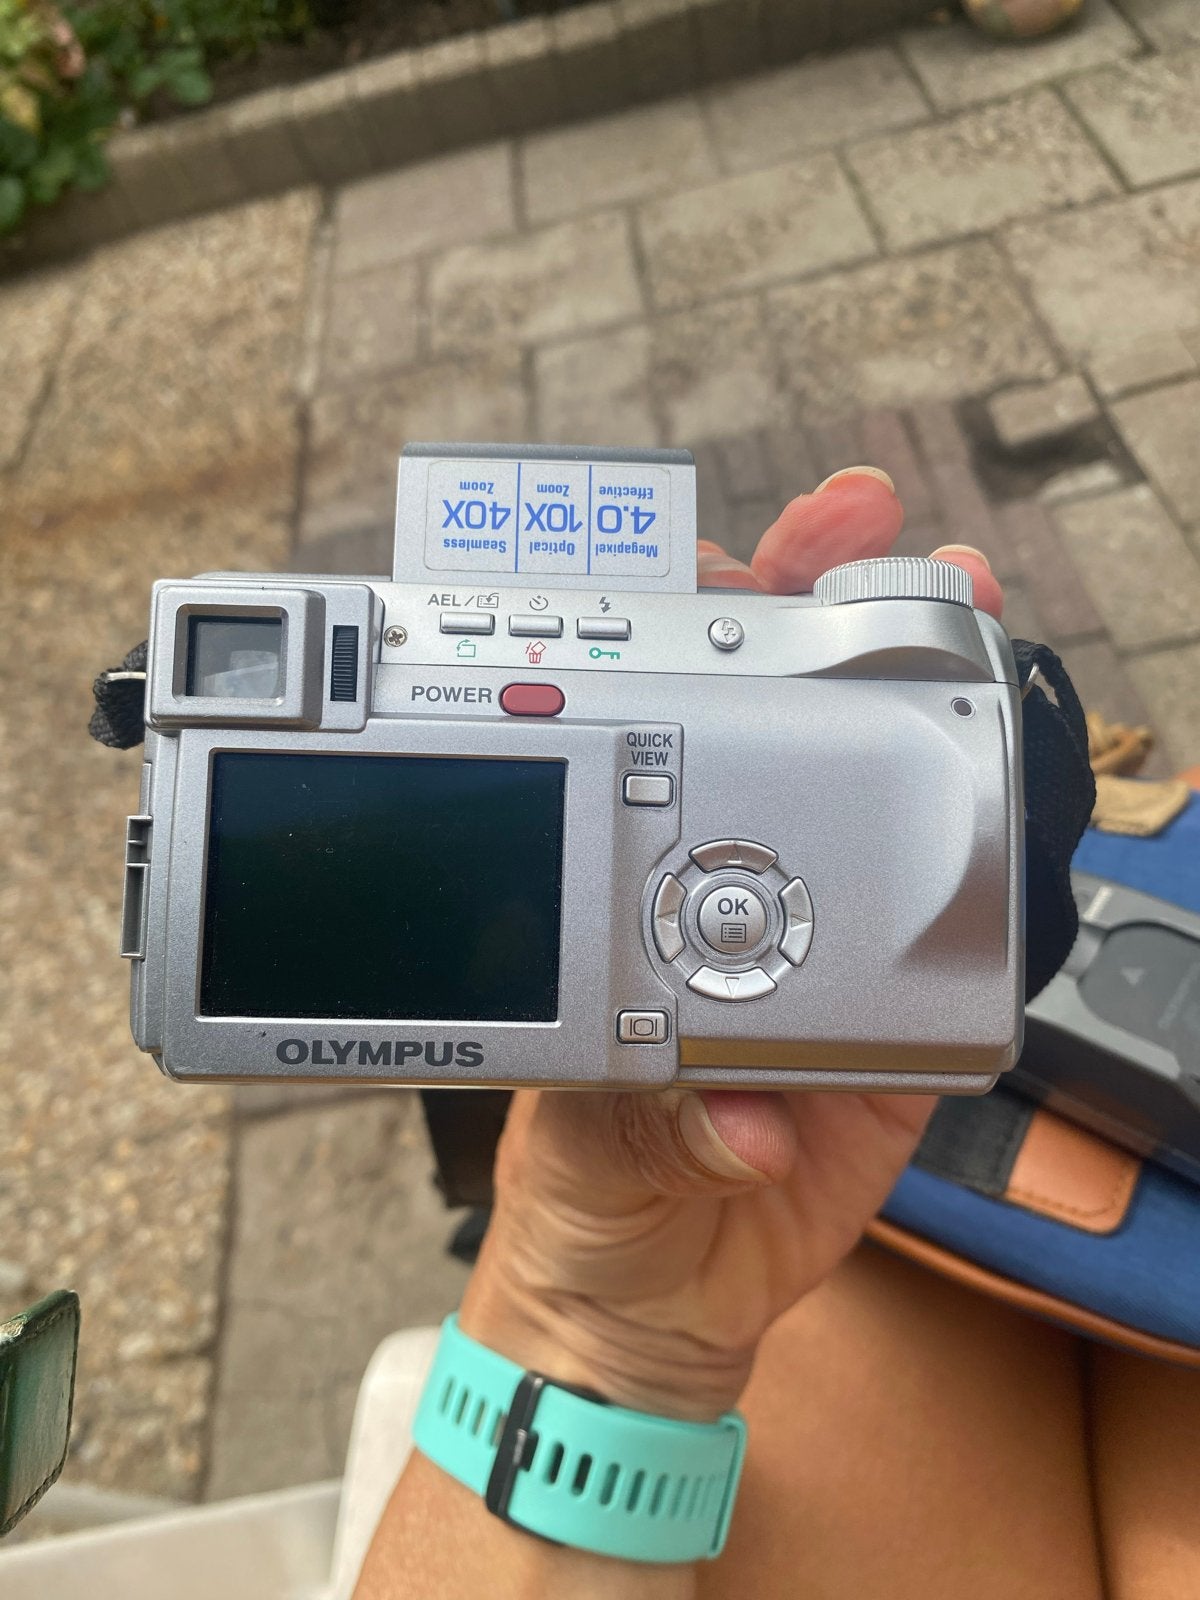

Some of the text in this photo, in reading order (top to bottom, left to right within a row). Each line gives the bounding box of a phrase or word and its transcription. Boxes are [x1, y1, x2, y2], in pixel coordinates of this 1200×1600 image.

[460, 481, 494, 495] Zoom
[537, 484, 569, 497] Zoom
[599, 485, 654, 500] Effective
[442, 500, 511, 530] 40X
[524, 502, 583, 532] 10X
[597, 505, 656, 534] 4.0
[443, 538, 506, 553] Seamless
[529, 540, 575, 555] Optical
[595, 542, 658, 558] Megapixel
[411, 685, 492, 703] POWER
[626, 731, 673, 748] QUICK
[631, 750, 668, 766] VIEW
[717, 898, 749, 916] OK
[276, 1038, 484, 1067] OLYMPUS
